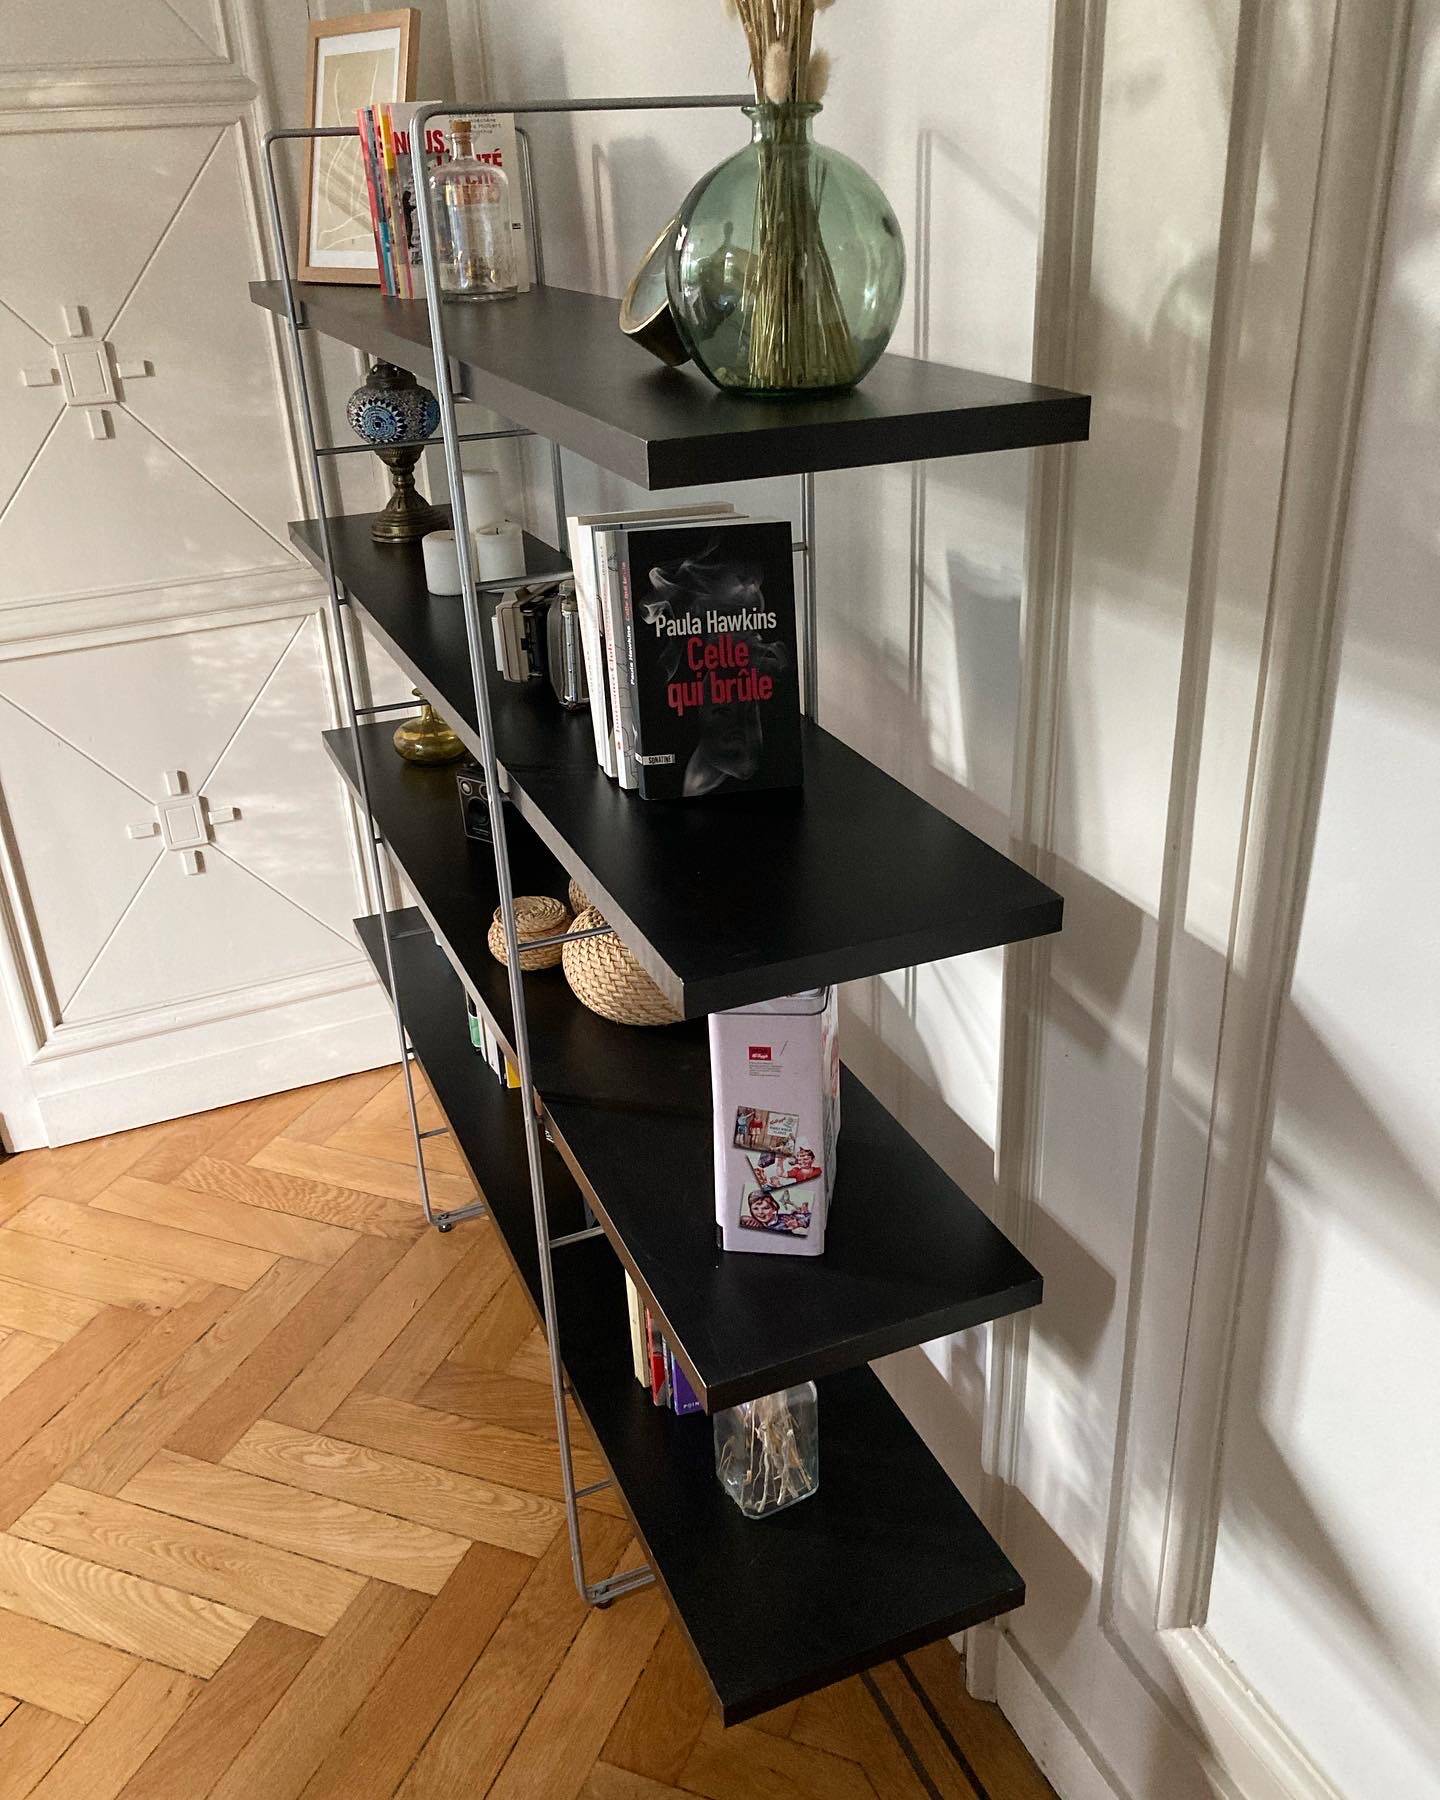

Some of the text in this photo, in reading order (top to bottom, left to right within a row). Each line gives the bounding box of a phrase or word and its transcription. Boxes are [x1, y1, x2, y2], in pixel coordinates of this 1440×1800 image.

[394, 129, 451, 156] NUS,
[656, 607, 777, 637] Paula Hawkins
[687, 633, 750, 671] Celle
[667, 668, 773, 716] qui brûle
